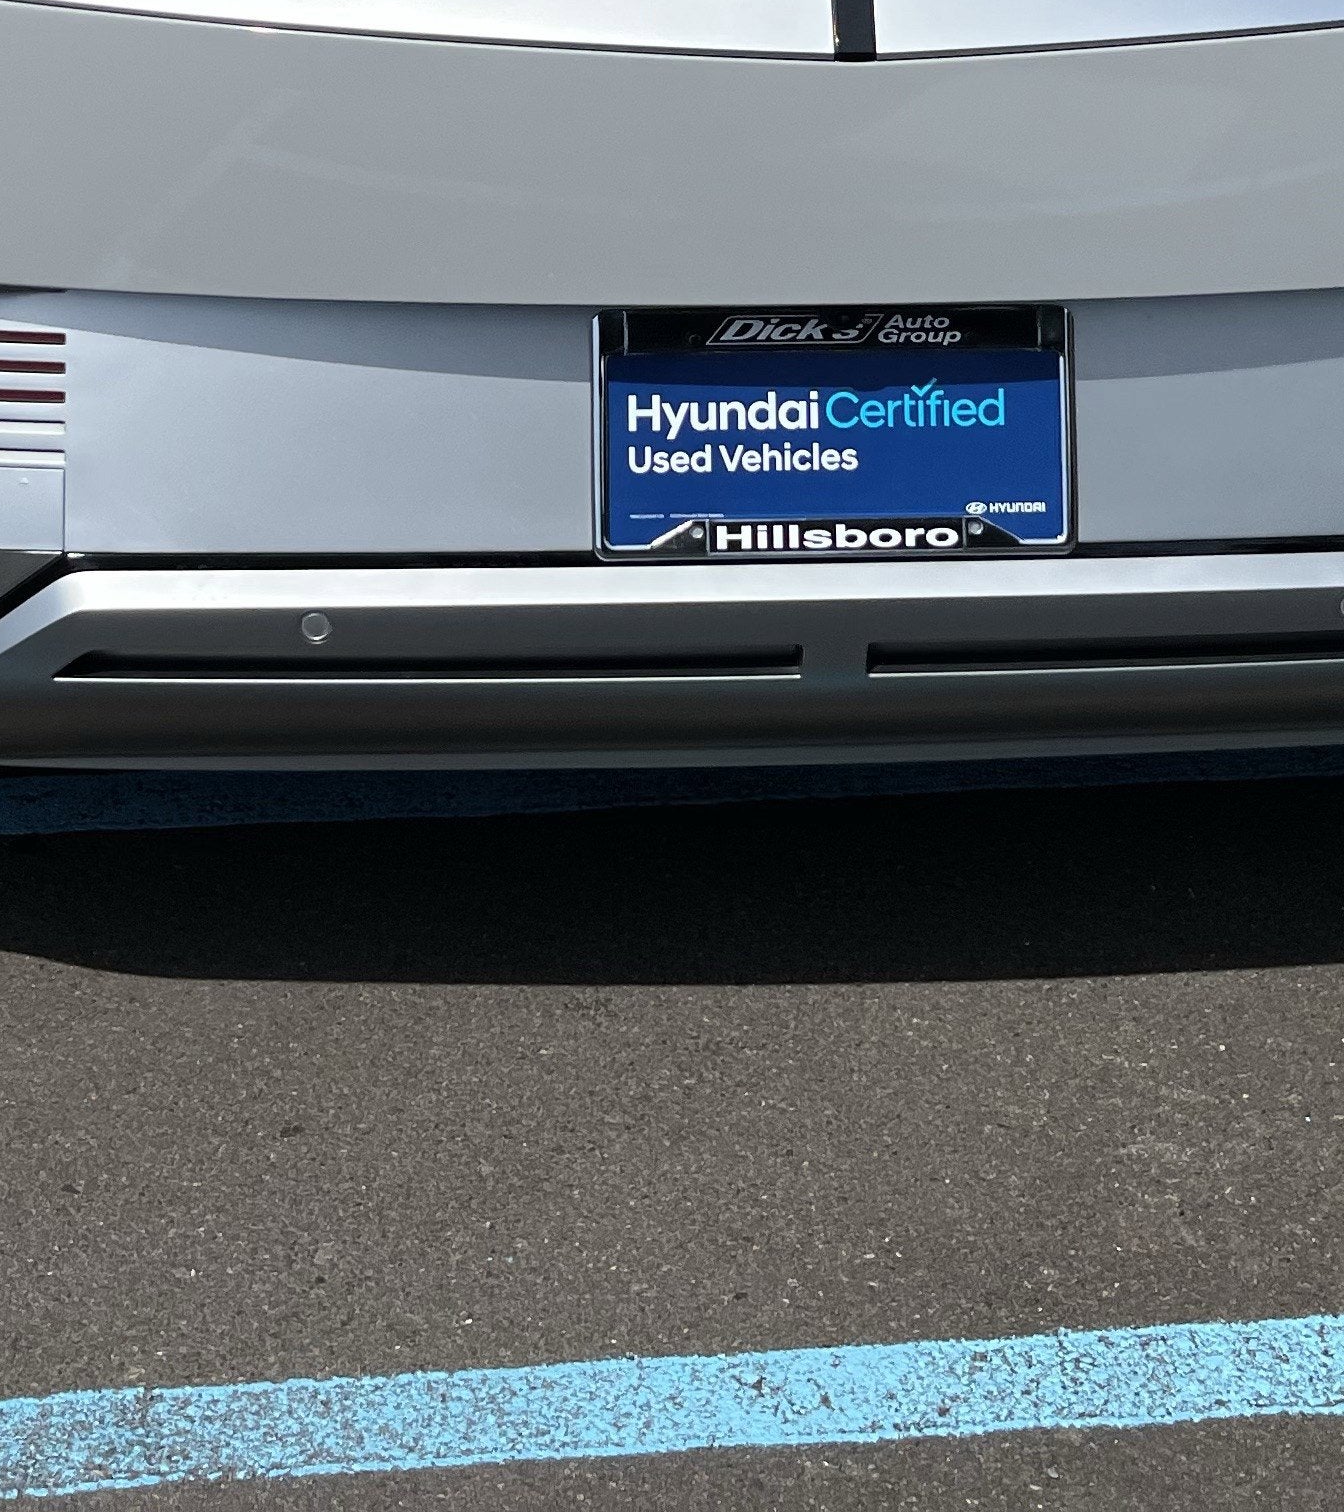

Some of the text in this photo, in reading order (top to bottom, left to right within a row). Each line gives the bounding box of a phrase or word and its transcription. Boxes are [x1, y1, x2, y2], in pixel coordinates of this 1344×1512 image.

[884, 314, 950, 329] Auto
[878, 328, 962, 346] Group
[627, 378, 1005, 440] Hyundai Certified
[628, 442, 858, 474] Used Vehicles
[989, 501, 1046, 513] HYUNDAI
[716, 524, 958, 550] Hillsboro
